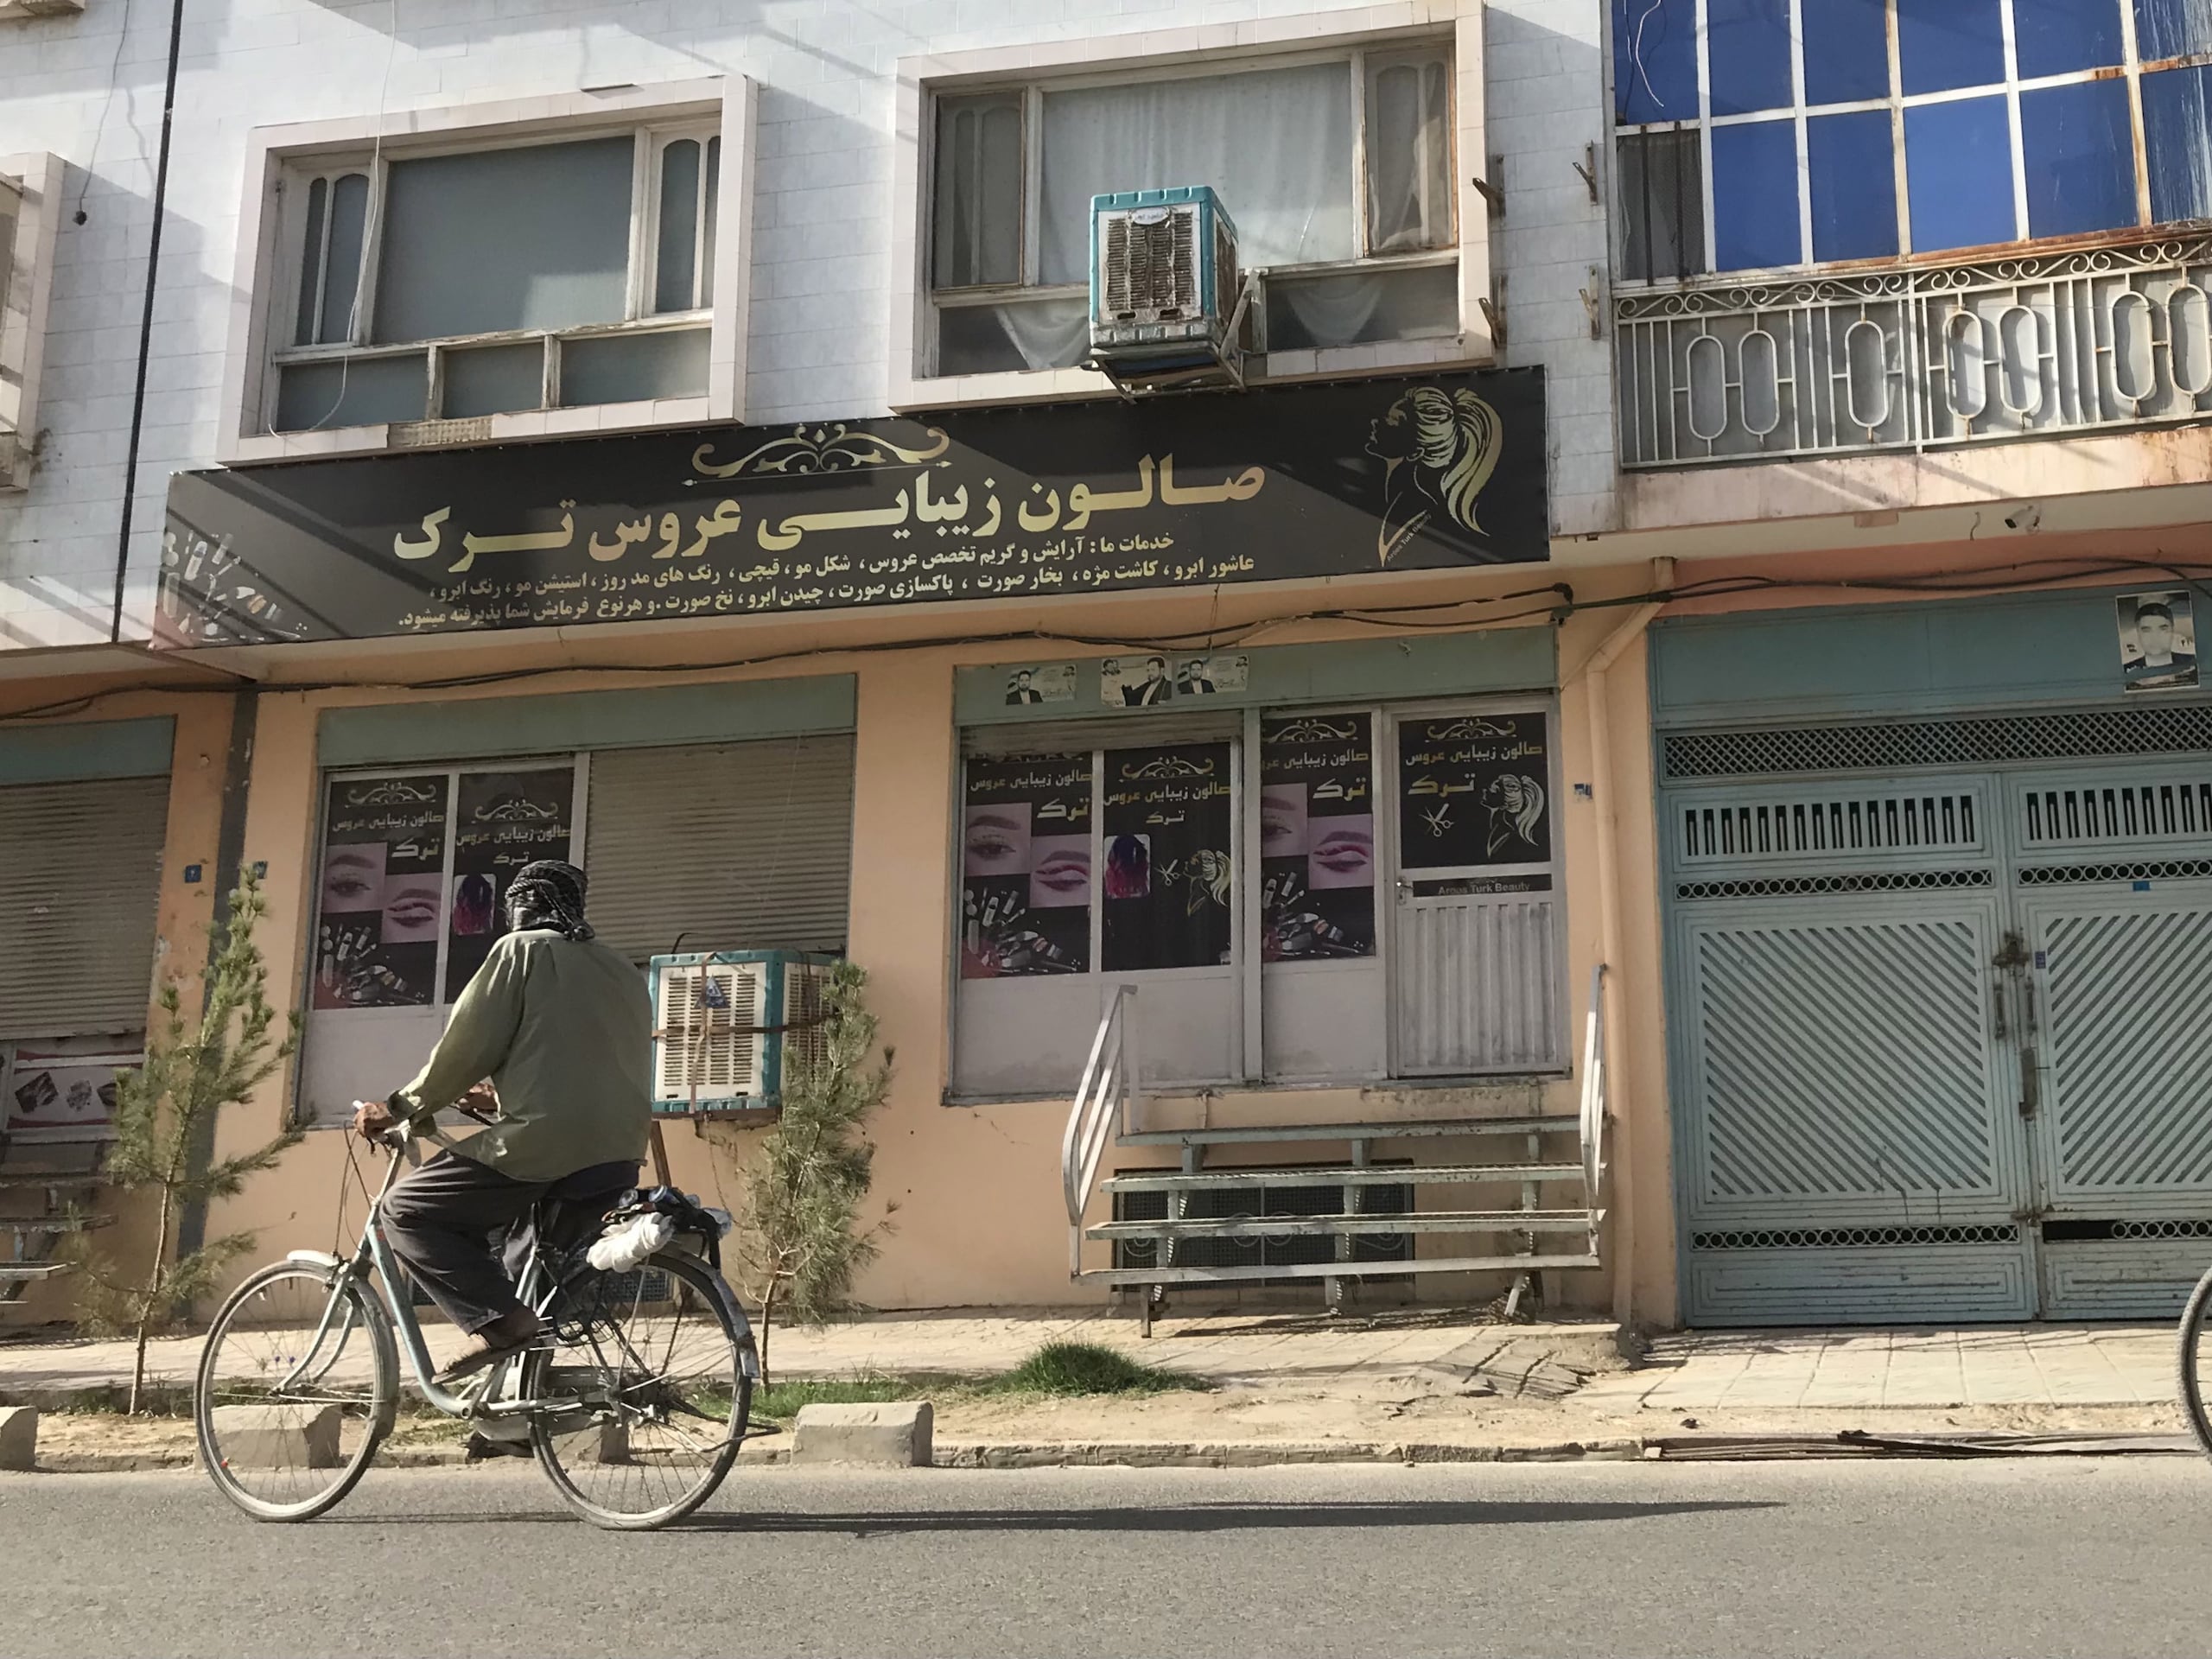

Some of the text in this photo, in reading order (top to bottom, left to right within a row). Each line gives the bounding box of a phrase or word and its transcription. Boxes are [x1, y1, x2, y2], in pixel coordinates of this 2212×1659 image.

[394, 453, 1266, 574] صالون زیبایی عروس ترک
[1033, 536, 1085, 562] آرایش
[1100, 537, 1115, 553] ما
[1119, 532, 1174, 551] خدمات
[868, 553, 918, 573] عروس
[921, 546, 977, 569] تخصص
[979, 542, 1016, 566] گریم
[1019, 549, 1029, 563] و
[687, 564, 721, 584] رنگ
[738, 558, 780, 582] قیچی
[795, 563, 812, 579] مو
[815, 554, 850, 577] شکل
[1083, 565, 1111, 586] مژه
[1114, 559, 1159, 579] کاشت
[1173, 556, 1205, 582] ابرو
[1208, 553, 1255, 578] عاشور
[535, 572, 588, 594] استیشن
[600, 573, 626, 592] روز
[630, 572, 651, 586] مد
[652, 567, 684, 588] های
[889, 574, 954, 599] پاکسازی
[977, 574, 1026, 592] صورت
[1029, 566, 1064, 590] بخار
[438, 580, 467, 602] ابرو
[515, 582, 532, 598] مو
[715, 588, 734, 611] نخ
[747, 586, 778, 608] ابرو
[779, 586, 823, 606] چیدن
[837, 582, 887, 601] صورت
[505, 602, 531, 619] شما
[533, 596, 589, 622] فرمایش
[664, 594, 711, 613] صورت
[1331, 748, 1369, 766] صالون
[1405, 741, 1543, 766] صالون زیبایی عروس
[970, 769, 1093, 791] صالون زیبایی عروس
[1313, 777, 1366, 801] ترک
[1408, 772, 1476, 798] ترک
[1103, 781, 1231, 806] صالون زیبایی عروس
[1037, 798, 1090, 821] ترک
[1146, 810, 1185, 825] ترک
[391, 837, 440, 861] ترک
[1471, 884, 1493, 893] Turk
[1495, 881, 1530, 893] Beauty
